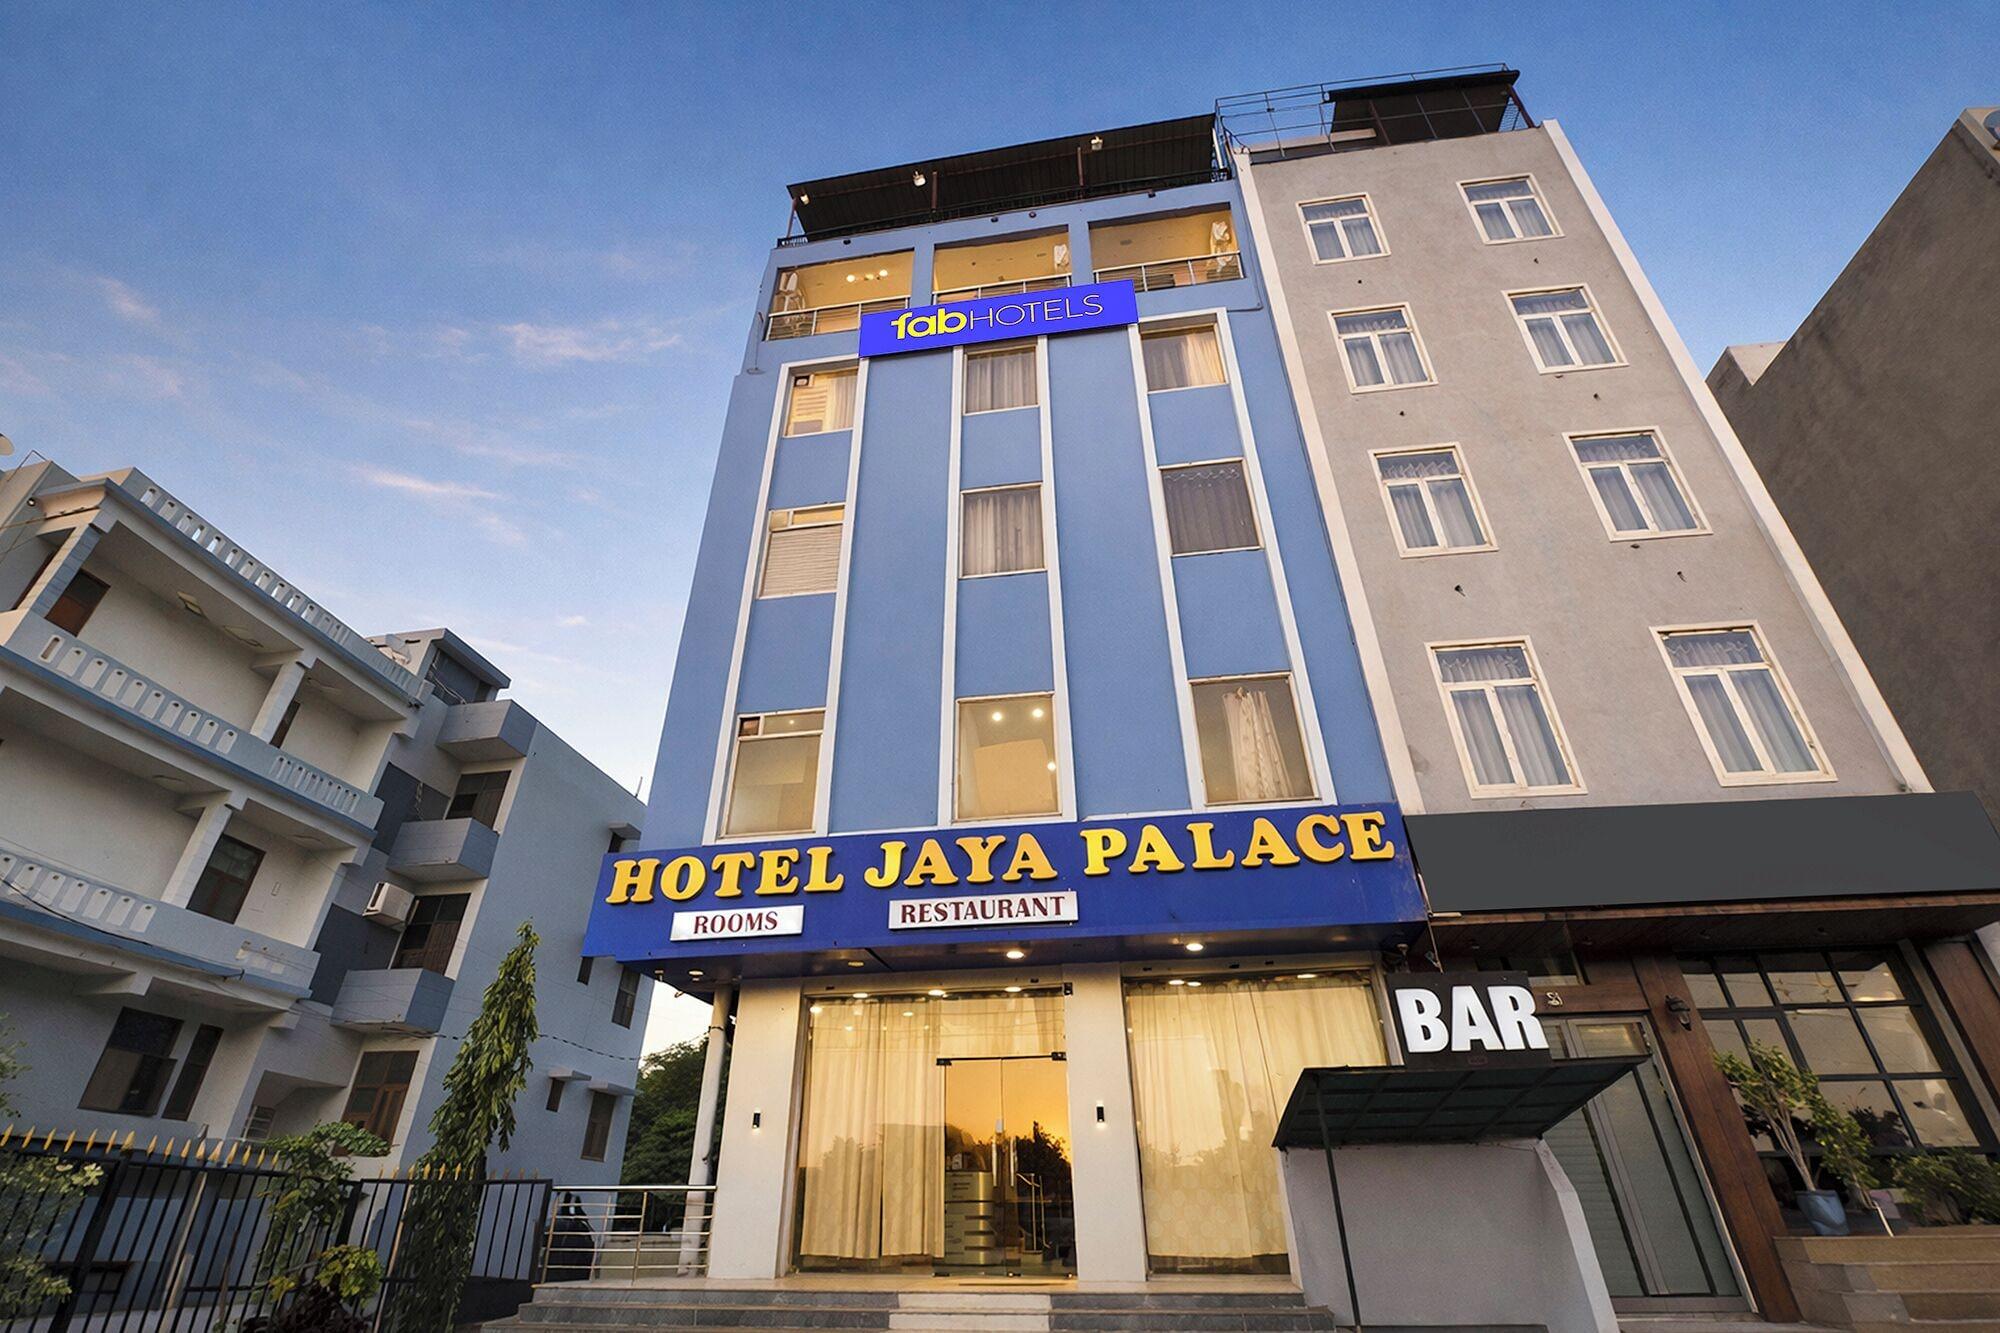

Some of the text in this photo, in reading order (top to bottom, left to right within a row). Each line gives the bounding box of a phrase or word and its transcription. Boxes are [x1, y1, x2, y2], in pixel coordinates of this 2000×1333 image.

[890, 294, 1104, 340] fabHOTELS
[605, 810, 1396, 904] HOTEL JAYA PALACE
[693, 911, 779, 935] ROOMS
[901, 896, 1066, 925] RESTAURANT
[1394, 985, 1549, 1054] BAR
